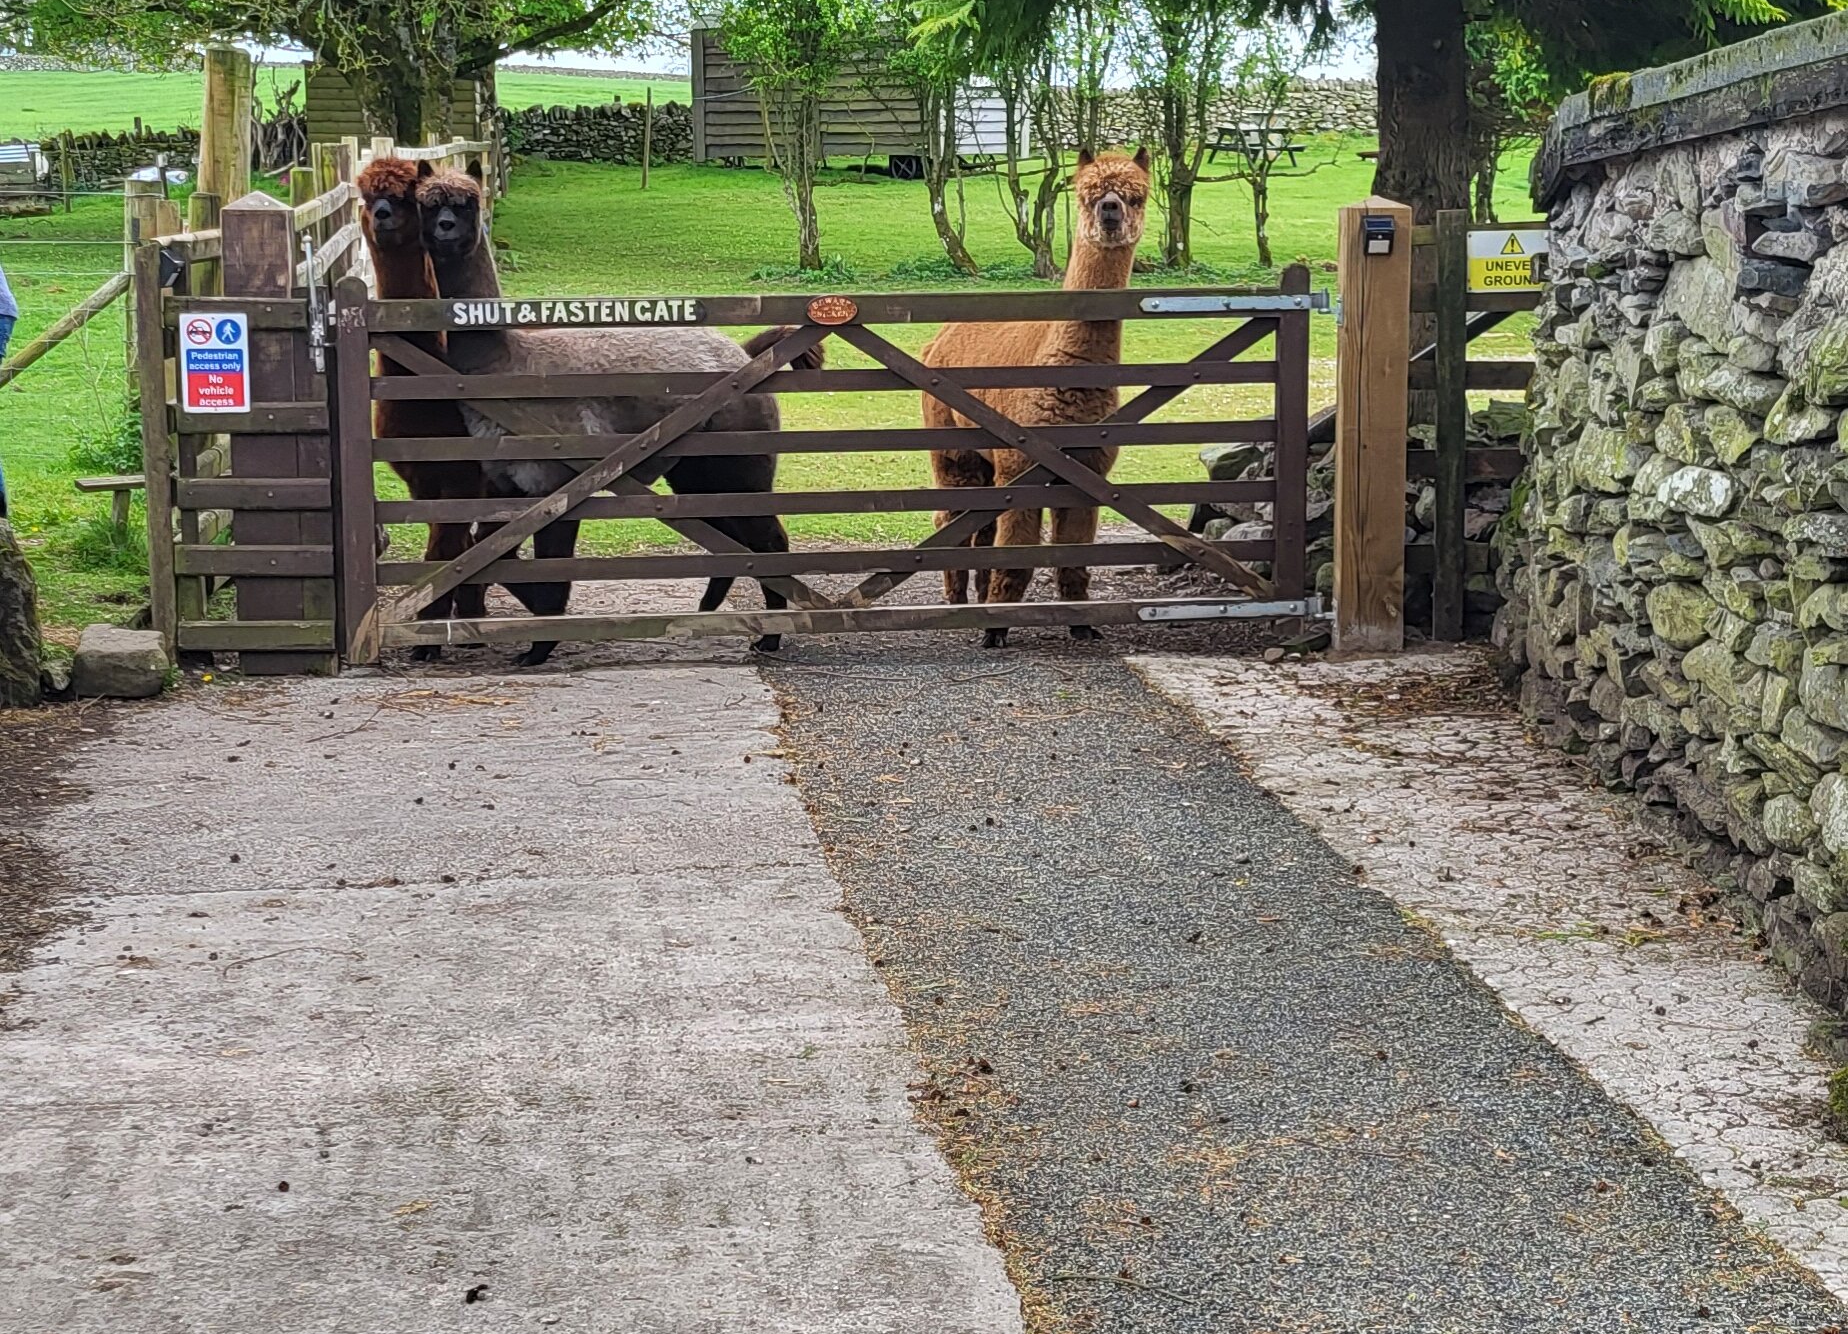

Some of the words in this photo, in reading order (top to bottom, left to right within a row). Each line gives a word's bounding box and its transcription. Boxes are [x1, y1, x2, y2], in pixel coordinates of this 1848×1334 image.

[1485, 260, 1531, 272] UNEVE
[1483, 275, 1540, 287] GROUN
[453, 302, 516, 325] SHUT
[517, 303, 537, 323] &
[541, 301, 629, 323] FASTEN
[634, 299, 697, 322] GATE
[191, 351, 239, 360] Pedestrian
[189, 362, 220, 370] access
[222, 361, 241, 372] only
[208, 374, 224, 384] No
[199, 386, 234, 396] vehicle
[199, 397, 234, 406] access
